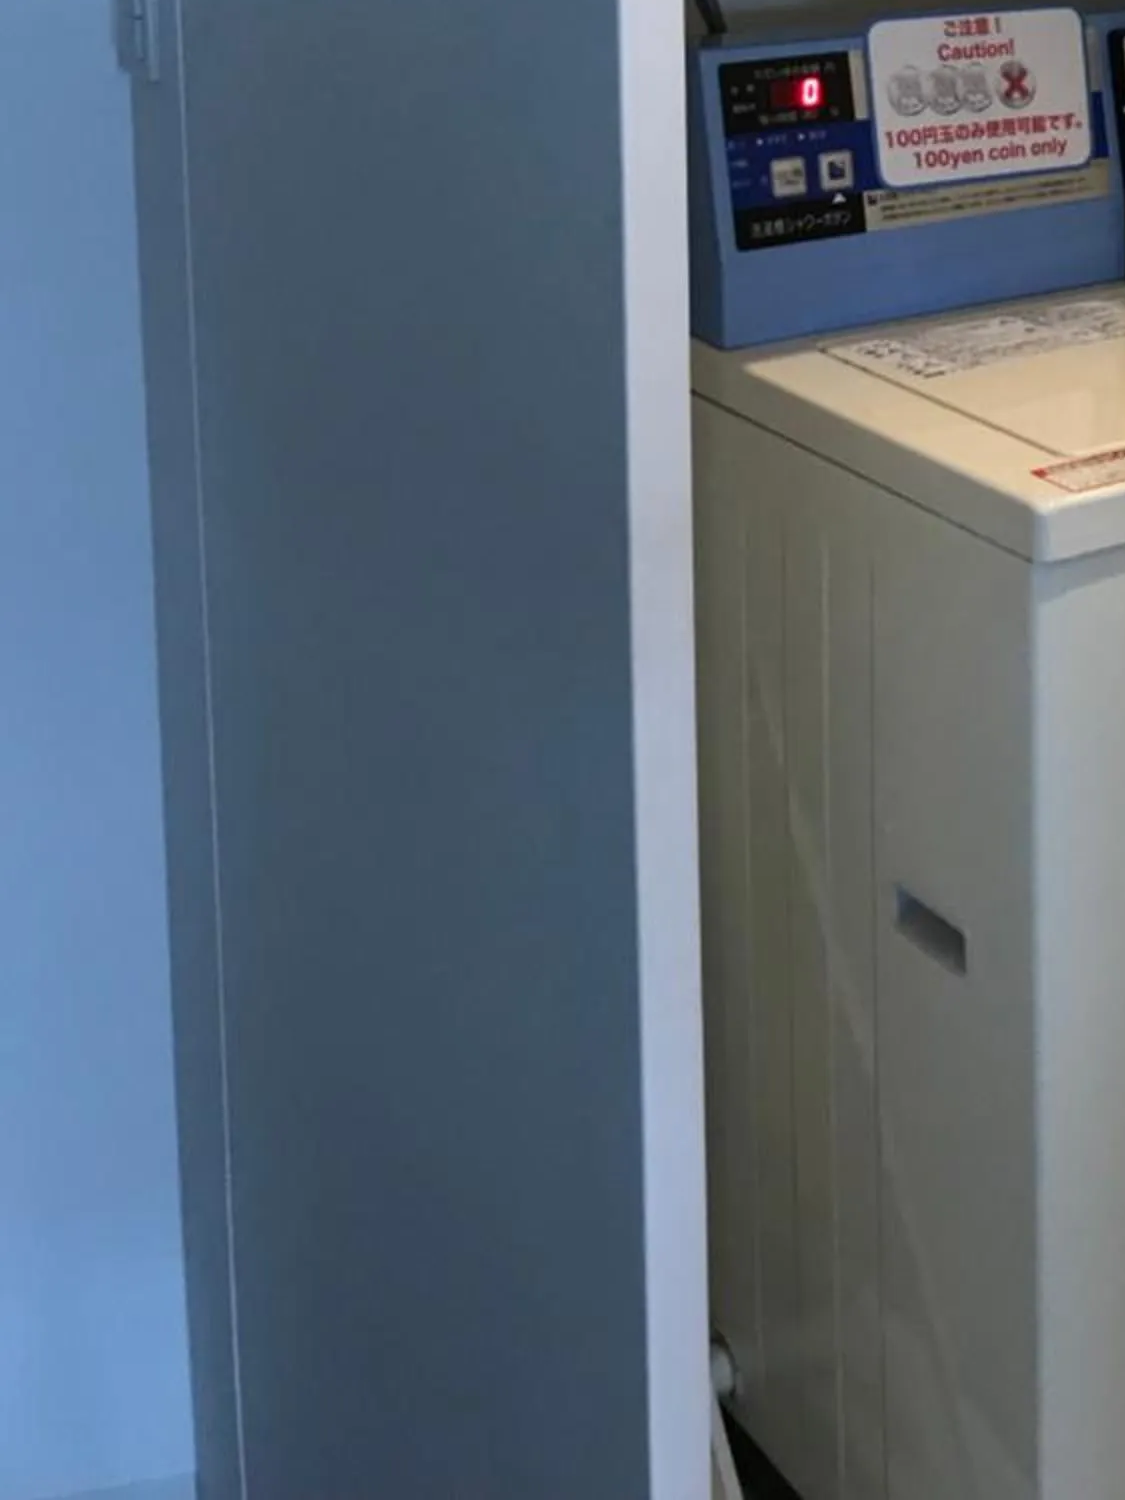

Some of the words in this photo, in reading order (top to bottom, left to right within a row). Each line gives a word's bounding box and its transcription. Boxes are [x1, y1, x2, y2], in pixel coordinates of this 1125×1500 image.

[937, 39, 1015, 61] Caution!
[800, 76, 821, 107] 0
[913, 149, 984, 169] 100yen
[988, 141, 1026, 161] coin
[1031, 137, 1067, 157] only
